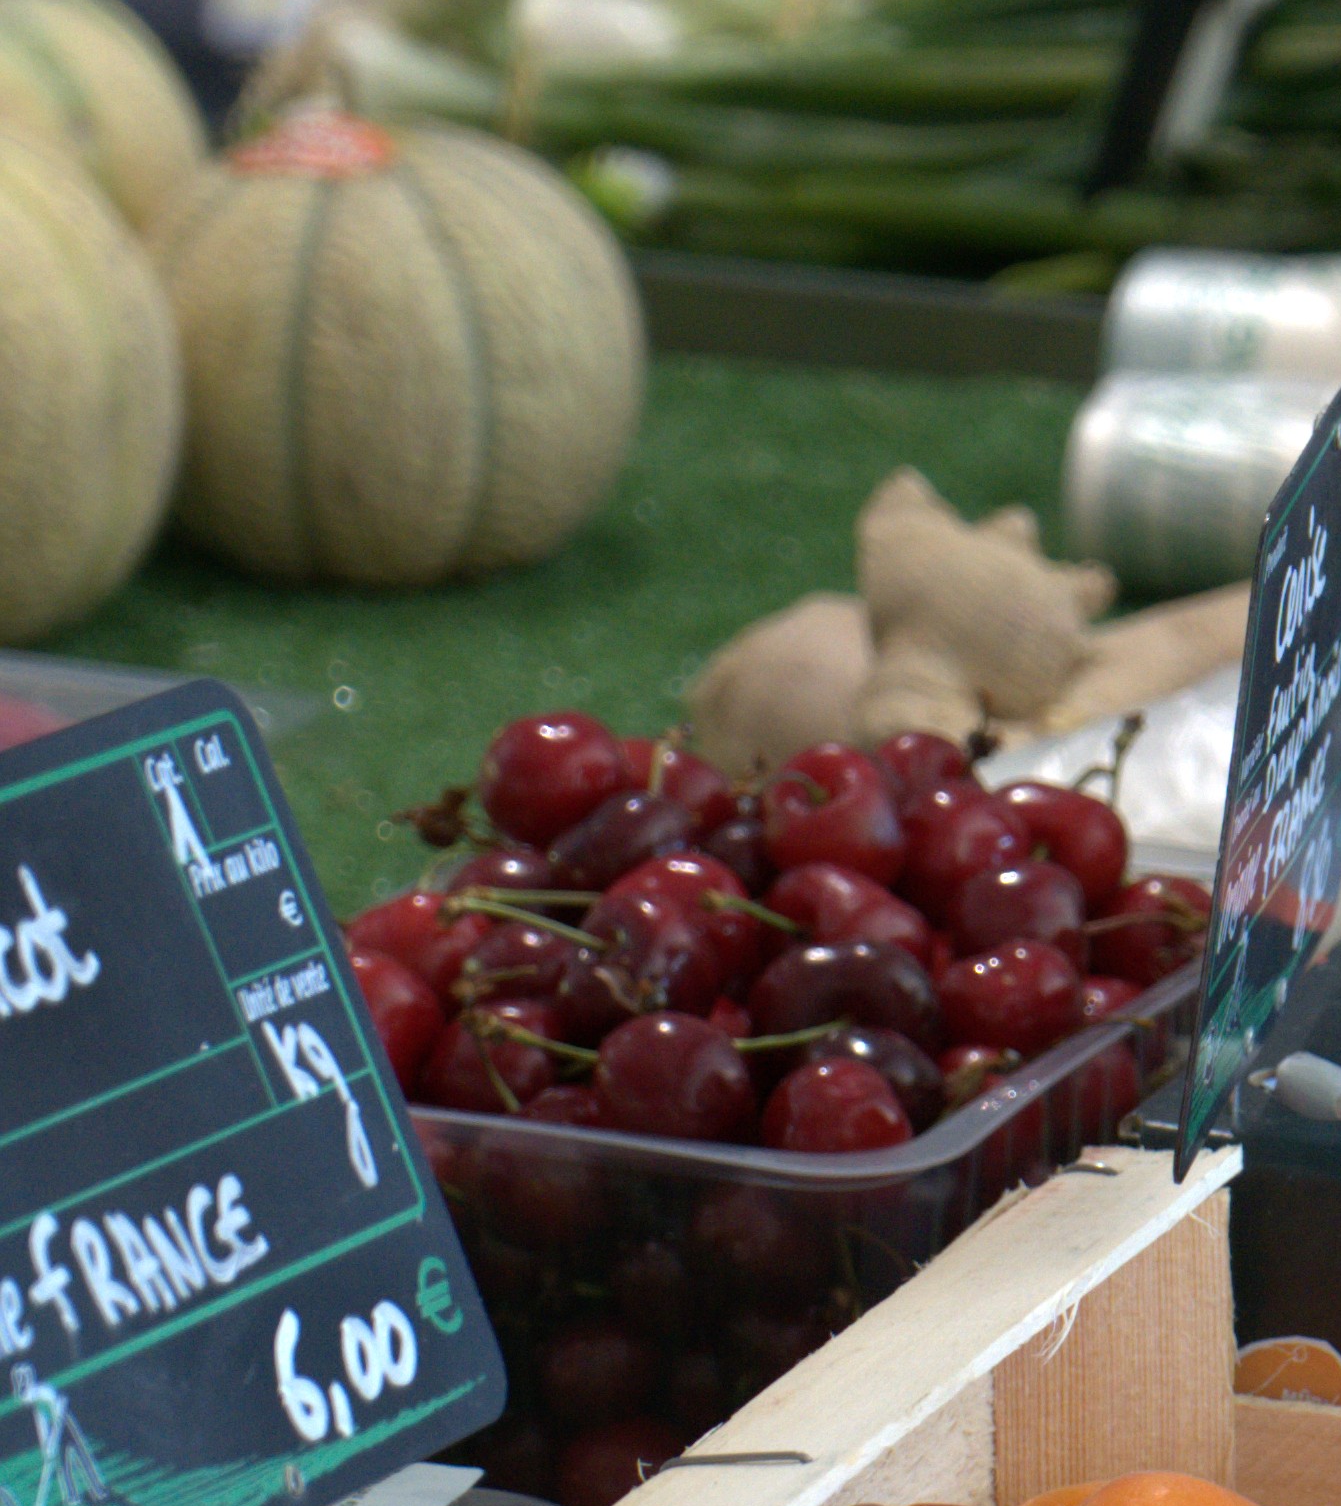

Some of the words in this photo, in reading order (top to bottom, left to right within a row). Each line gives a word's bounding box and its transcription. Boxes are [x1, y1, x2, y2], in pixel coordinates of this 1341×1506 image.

[279, 889, 303, 927] €
[274, 1299, 418, 1442] 6,00
[416, 1256, 463, 1334] €
